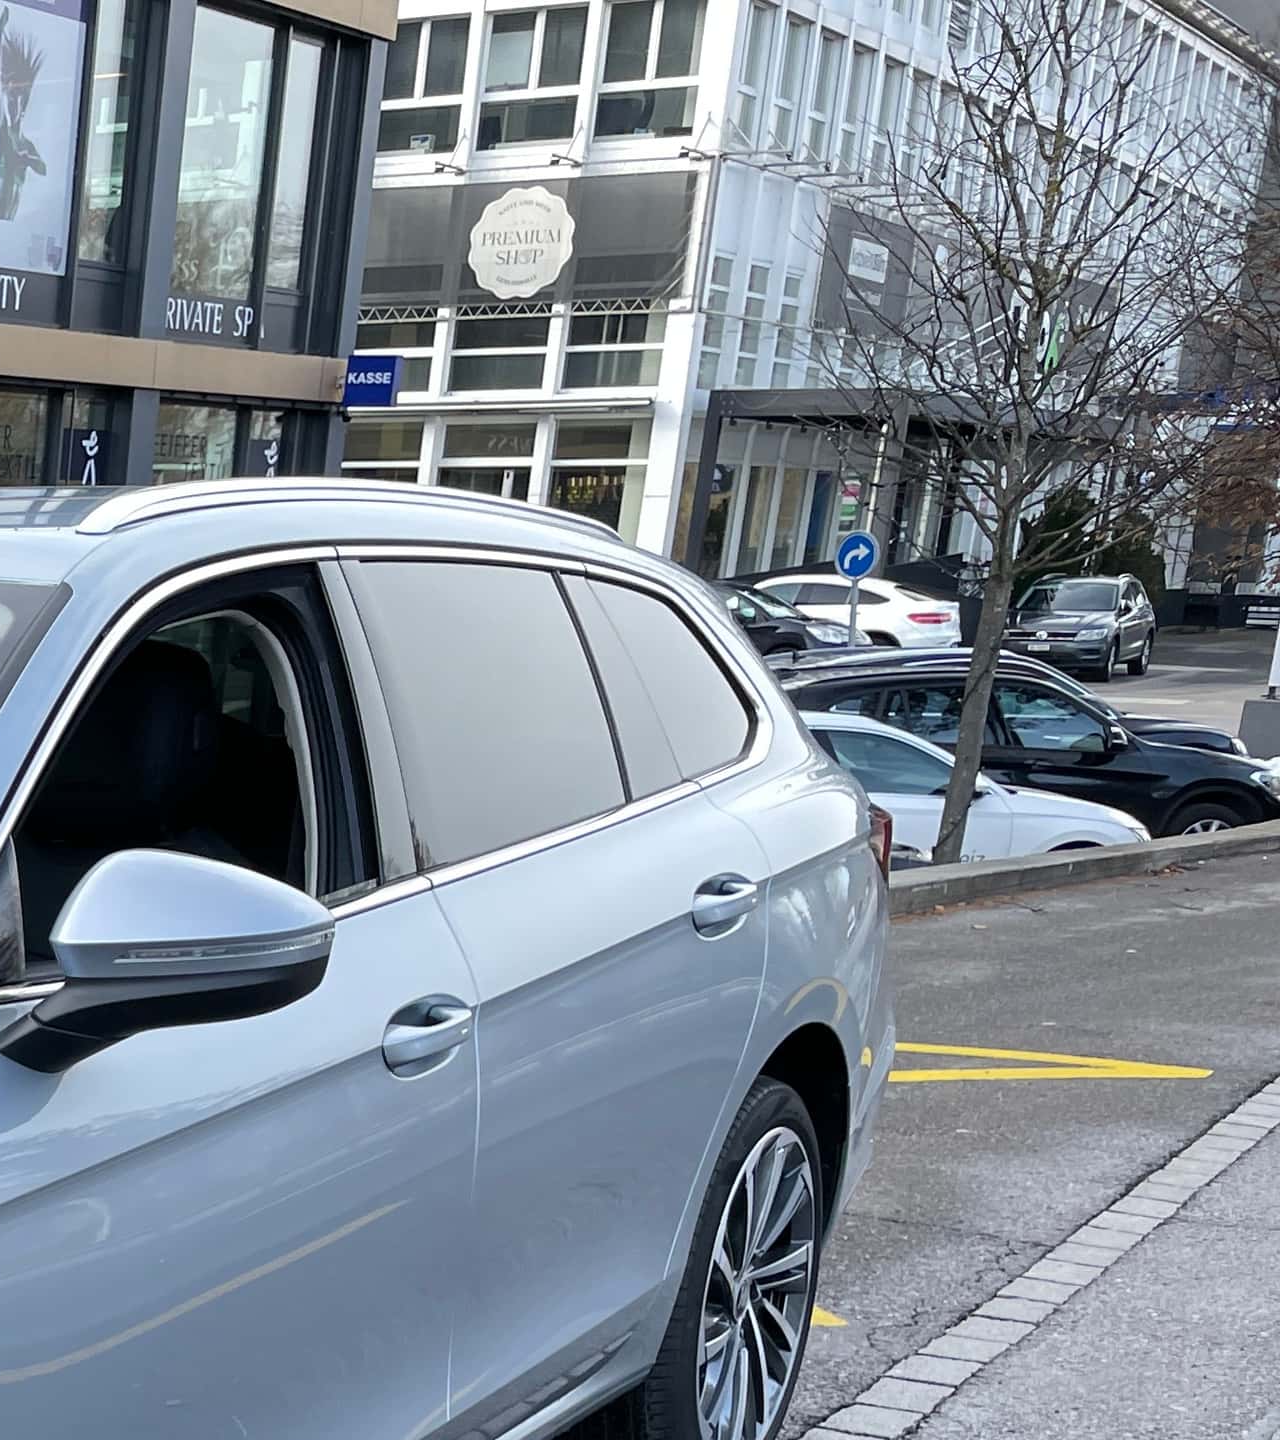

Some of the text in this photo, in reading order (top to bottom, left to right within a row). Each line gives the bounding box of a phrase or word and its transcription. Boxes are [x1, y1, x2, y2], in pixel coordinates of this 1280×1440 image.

[481, 229, 561, 247] PREMIUM
[495, 248, 544, 266] SHOP
[232, 305, 265, 339] SP
[347, 371, 393, 385] KASSE
